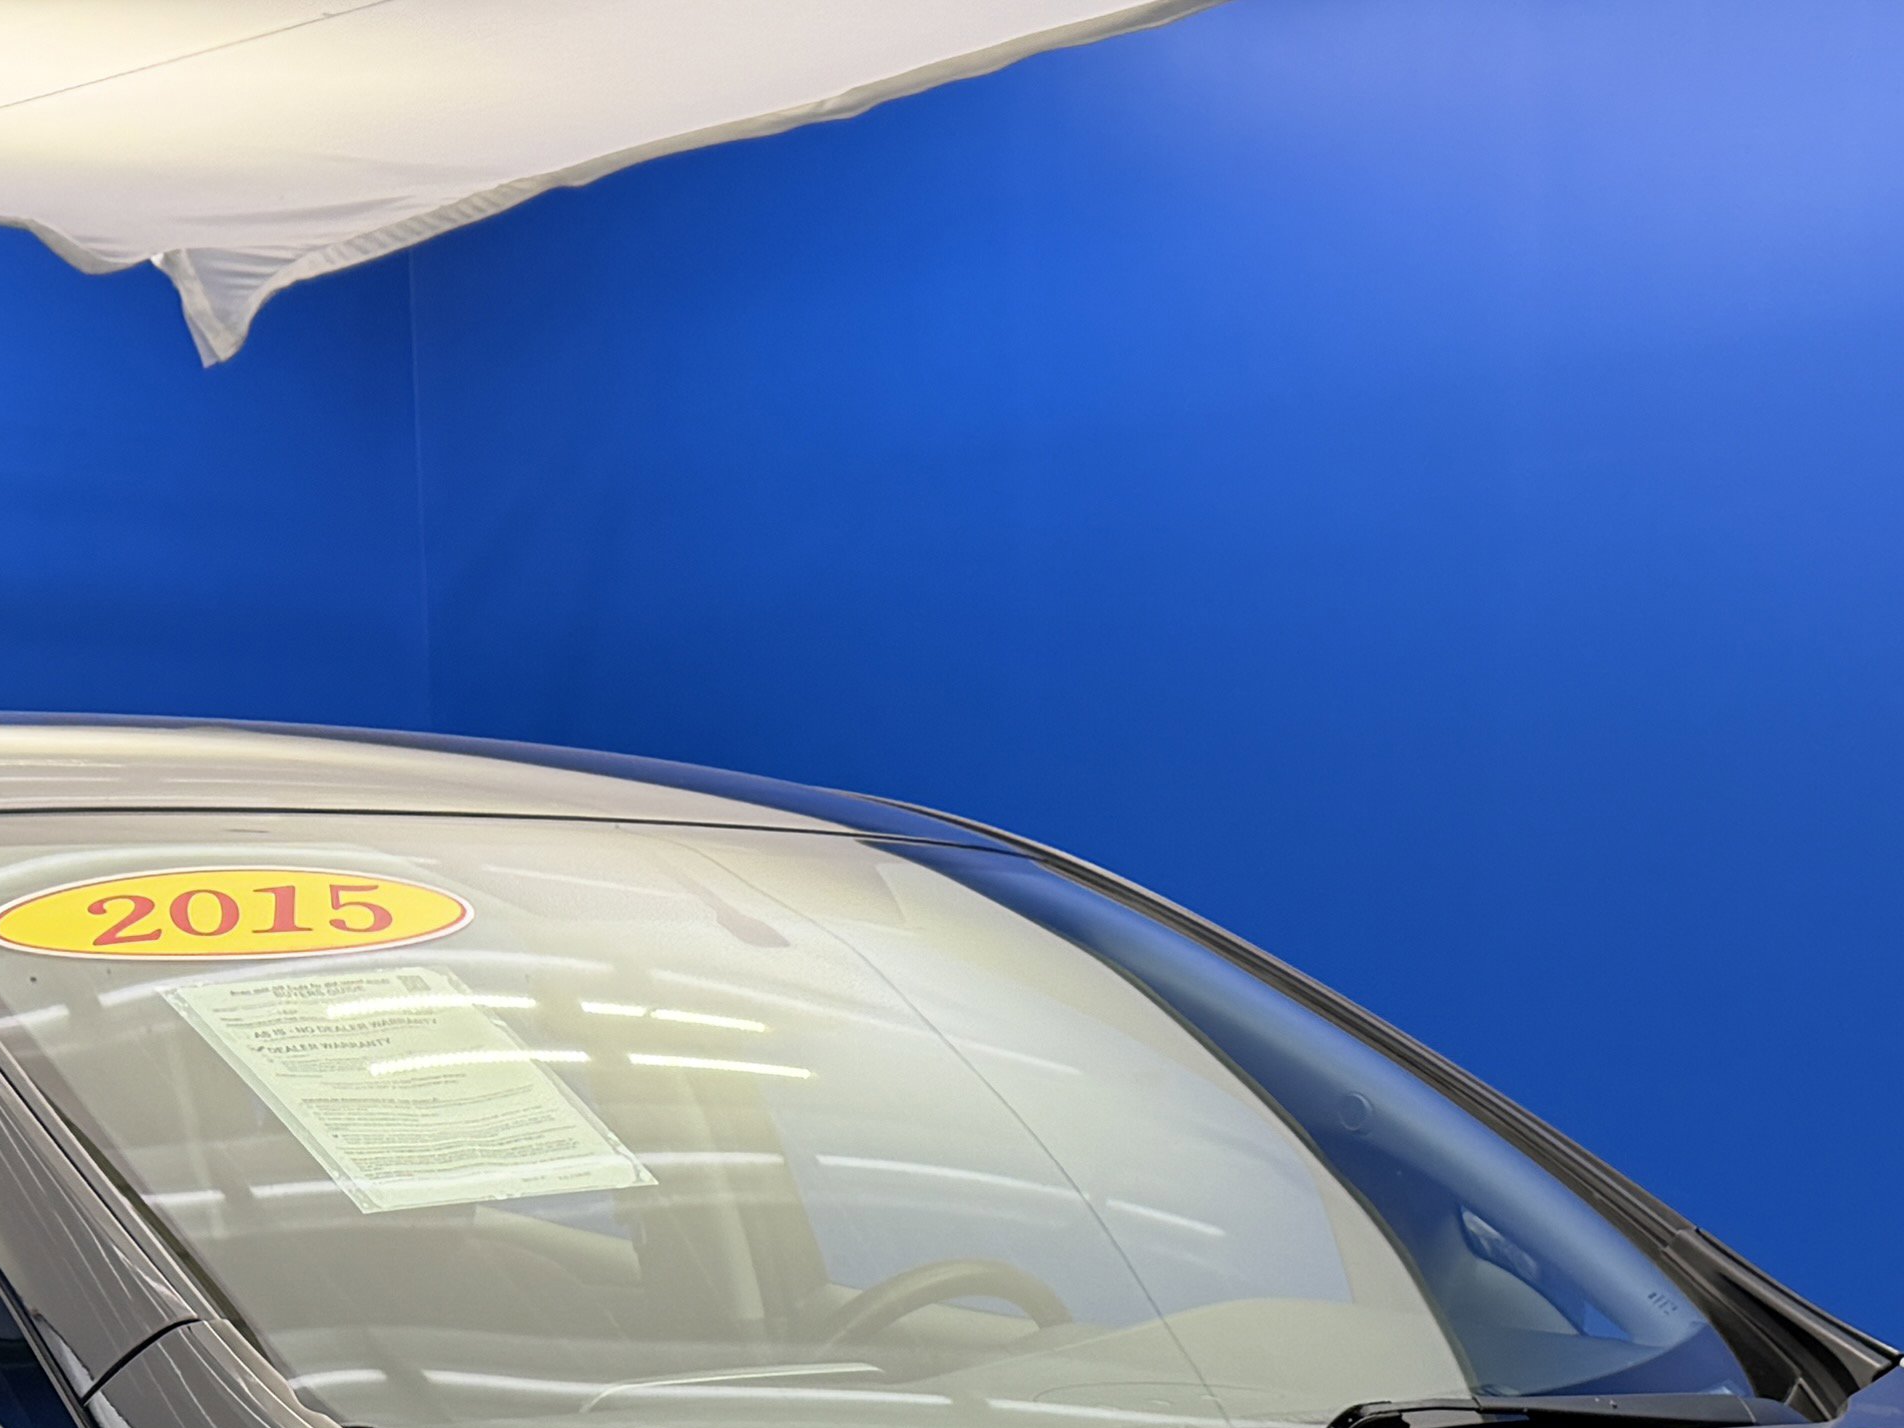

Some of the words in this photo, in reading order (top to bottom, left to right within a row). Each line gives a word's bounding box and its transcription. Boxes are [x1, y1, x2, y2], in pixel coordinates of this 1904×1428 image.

[87, 883, 393, 946] 2015
[268, 1042, 318, 1054] DEALER
[321, 1037, 392, 1050] WARRANTY
